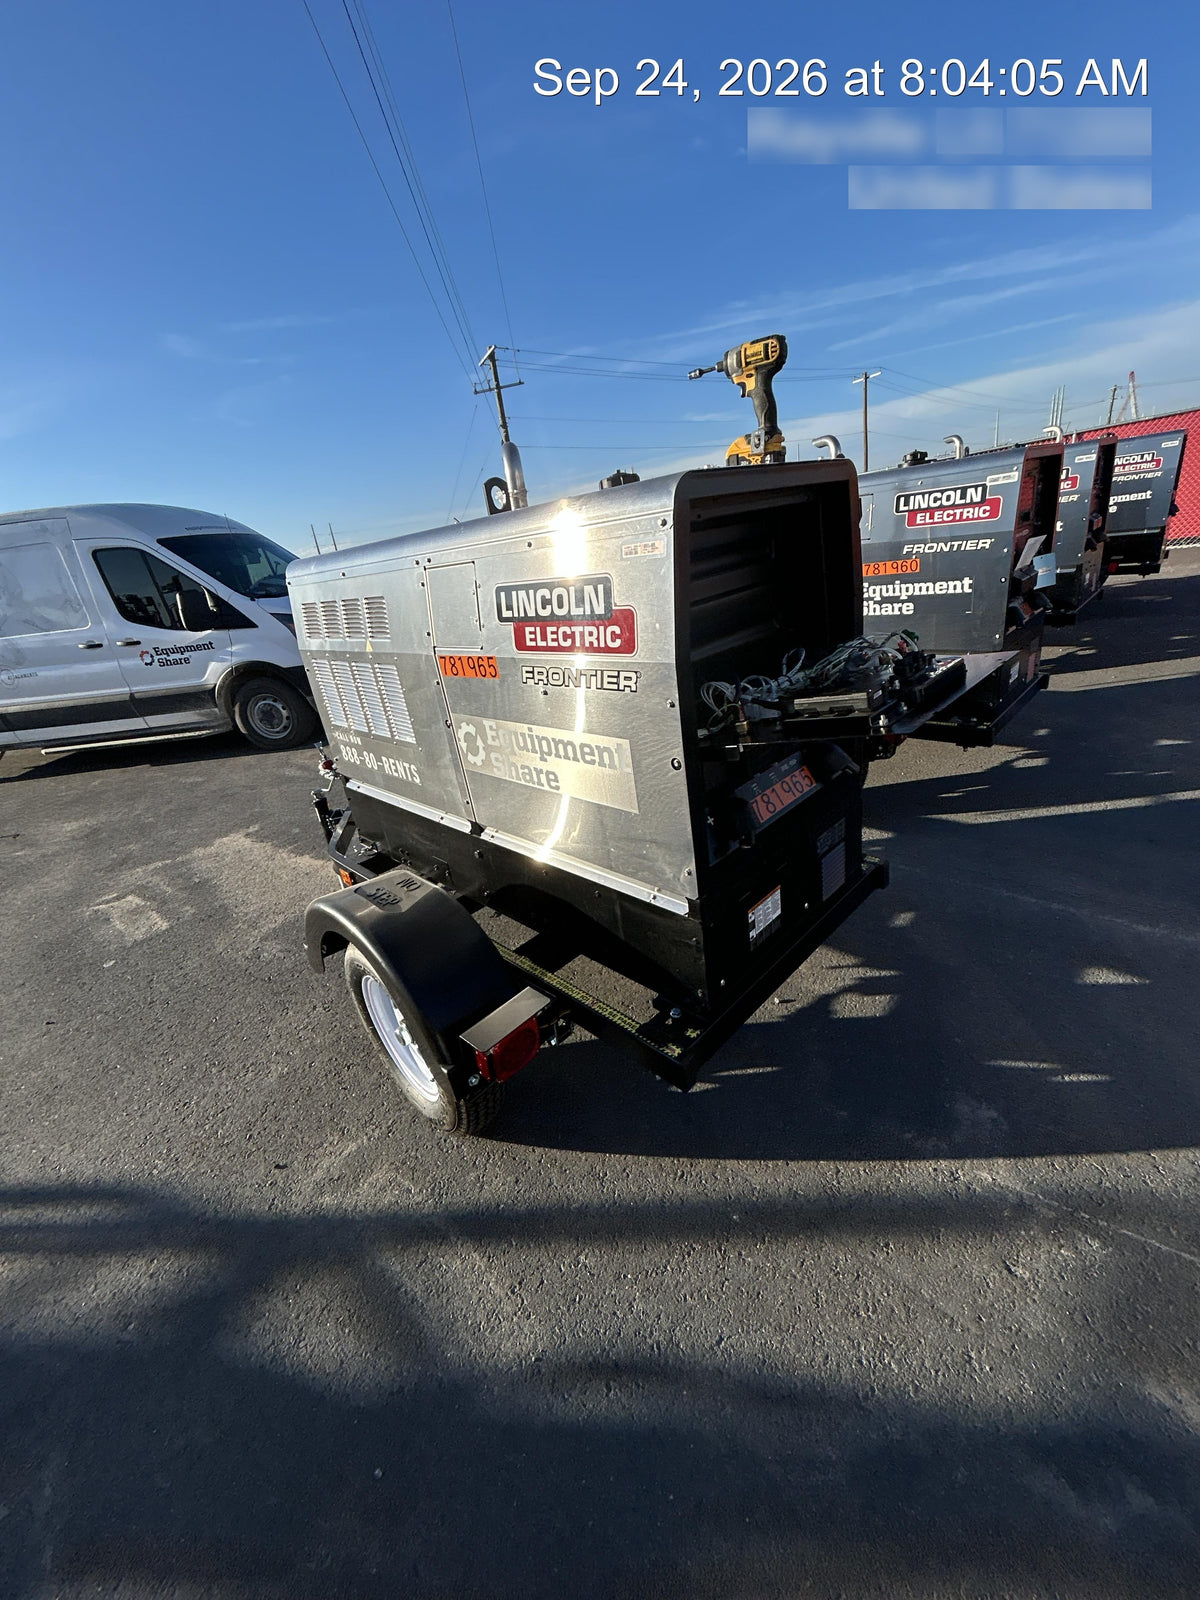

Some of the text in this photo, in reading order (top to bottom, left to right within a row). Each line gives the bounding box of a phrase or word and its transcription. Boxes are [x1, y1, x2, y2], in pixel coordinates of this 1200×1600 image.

[1114, 453, 1153, 465] NCOLN
[1114, 461, 1157, 473] ELECTRIC
[1112, 471, 1163, 482] FRONTIER
[899, 486, 983, 512] LINCOLN
[1109, 490, 1153, 505] pment
[916, 505, 991, 525] ELECTRIC
[902, 538, 992, 555] FRONTIER
[864, 559, 919, 576] 781960
[500, 583, 606, 618] LINCOLN
[524, 625, 622, 648] ELECTRIC
[152, 641, 215, 657] Equipment
[157, 656, 191, 668] Share
[439, 656, 498, 678] 781965
[521, 665, 639, 693] FRONTIER
[483, 720, 633, 774] Equipment
[340, 744, 421, 784] 888-80-RENTS
[491, 752, 561, 791] Share
[751, 767, 814, 821] 781965
[395, 877, 422, 892] NO
[366, 887, 401, 907] STEP
